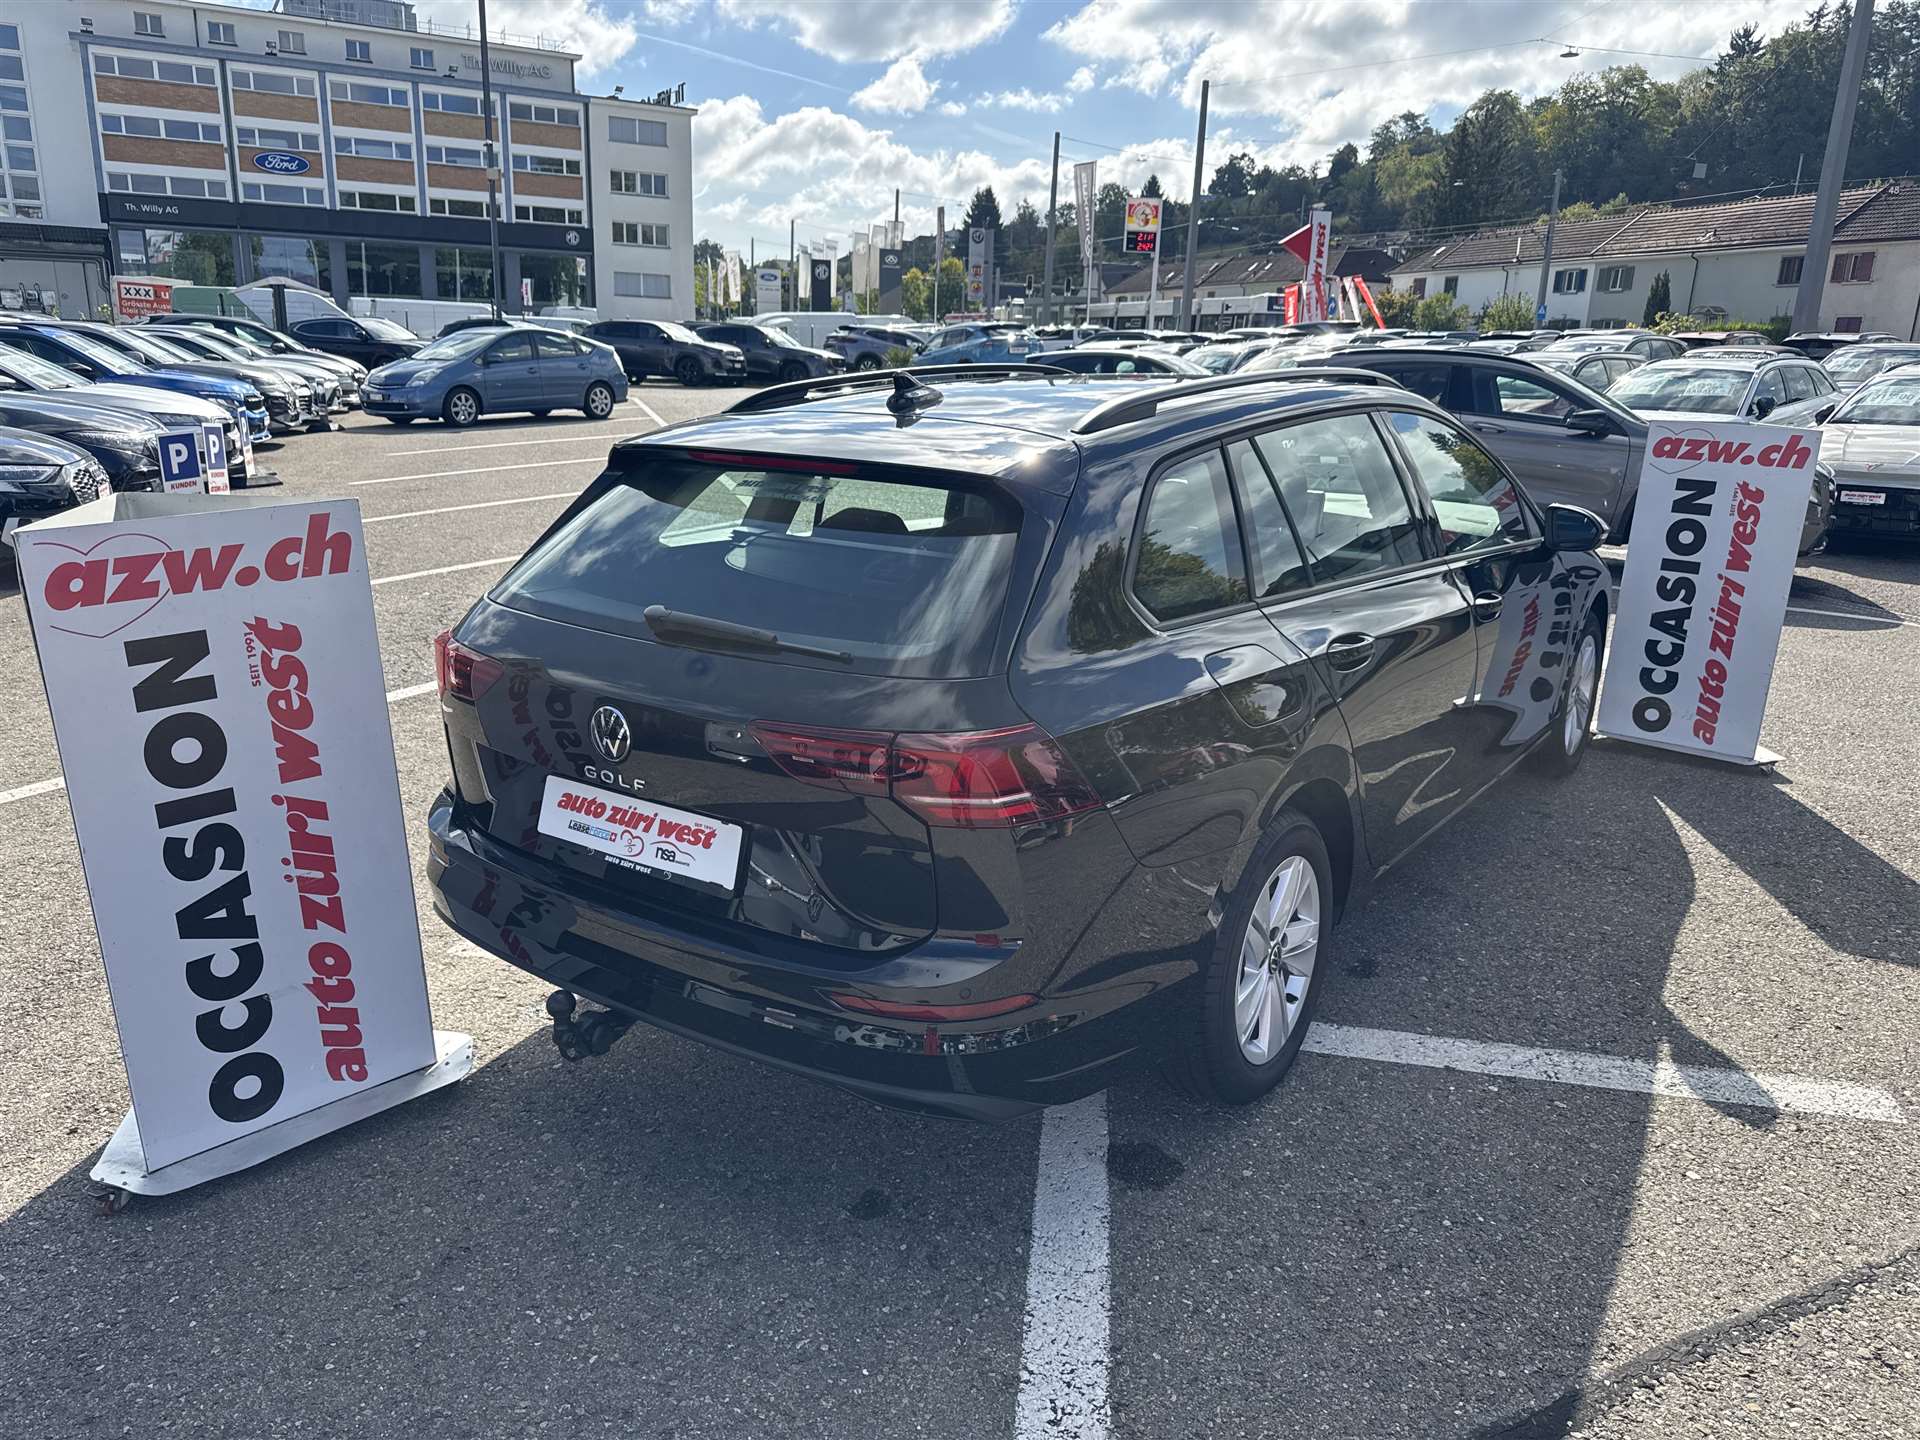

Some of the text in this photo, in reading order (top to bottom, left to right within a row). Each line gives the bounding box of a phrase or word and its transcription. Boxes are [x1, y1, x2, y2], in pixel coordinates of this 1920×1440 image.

[489, 56, 526, 79] Willy
[528, 63, 553, 79] AG
[264, 154, 299, 171] Ford
[125, 203, 179, 215] Th. Willy AG
[168, 443, 188, 474] P
[208, 434, 219, 464] P
[1652, 434, 1811, 470] azw.ch
[171, 480, 197, 491] KUNDEN
[44, 512, 352, 611] azw.ch
[1632, 478, 1717, 733] OCCASION
[1692, 480, 1766, 746] auto züri west
[244, 631, 261, 687] SEIT 1991
[584, 765, 645, 790] GOLF
[557, 792, 717, 849] auto züri west
[243, 616, 369, 1082] auto züri west
[604, 855, 619, 864] auto
[635, 865, 652, 874] west
[655, 846, 676, 863] nsa
[123, 629, 285, 1123] OCCASION
